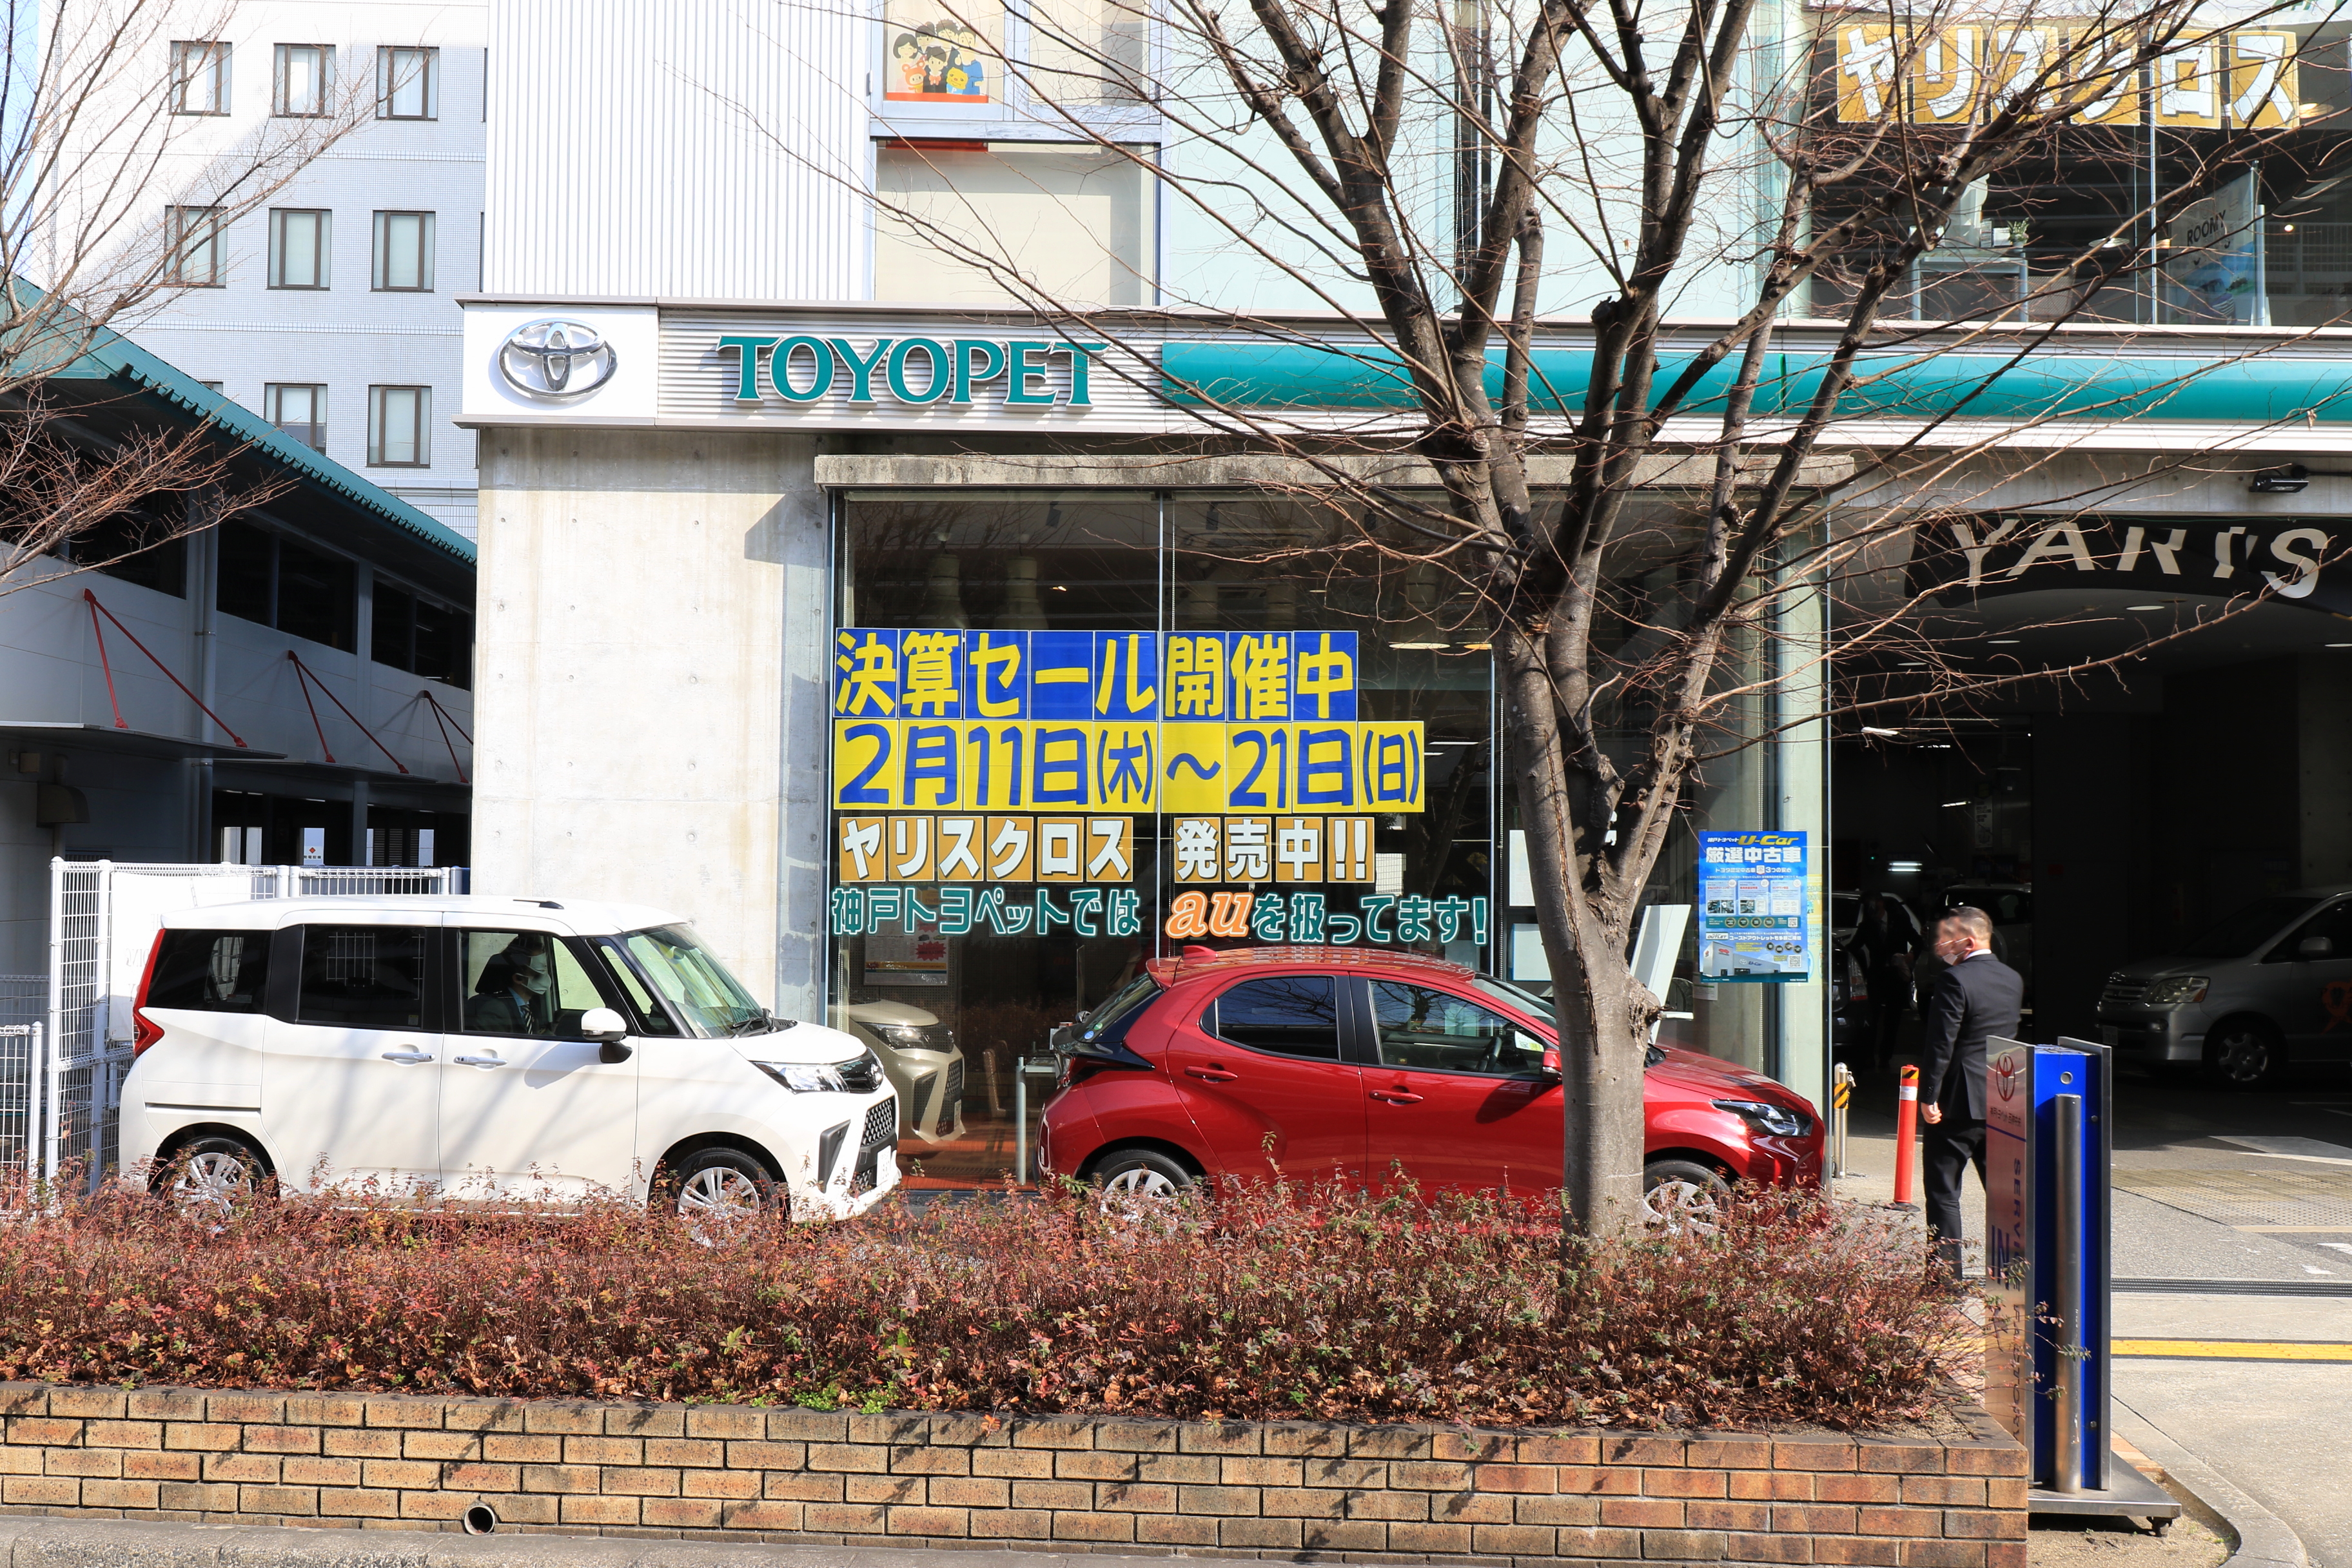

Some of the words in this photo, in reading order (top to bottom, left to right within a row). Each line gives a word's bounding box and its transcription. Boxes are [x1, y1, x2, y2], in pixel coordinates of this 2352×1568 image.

[1841, 28, 2294, 123] ヤリスクロス
[2187, 210, 2226, 246] ROOMY
[716, 335, 1112, 407] TOYOPET
[835, 631, 1353, 719] 決算セール開催中
[843, 820, 1130, 879] ヤリスクロス
[1705, 847, 1802, 863] 厳選中古車
[1737, 835, 1799, 845] U-Car
[831, 887, 1141, 936] 神戸トヨペットでは
